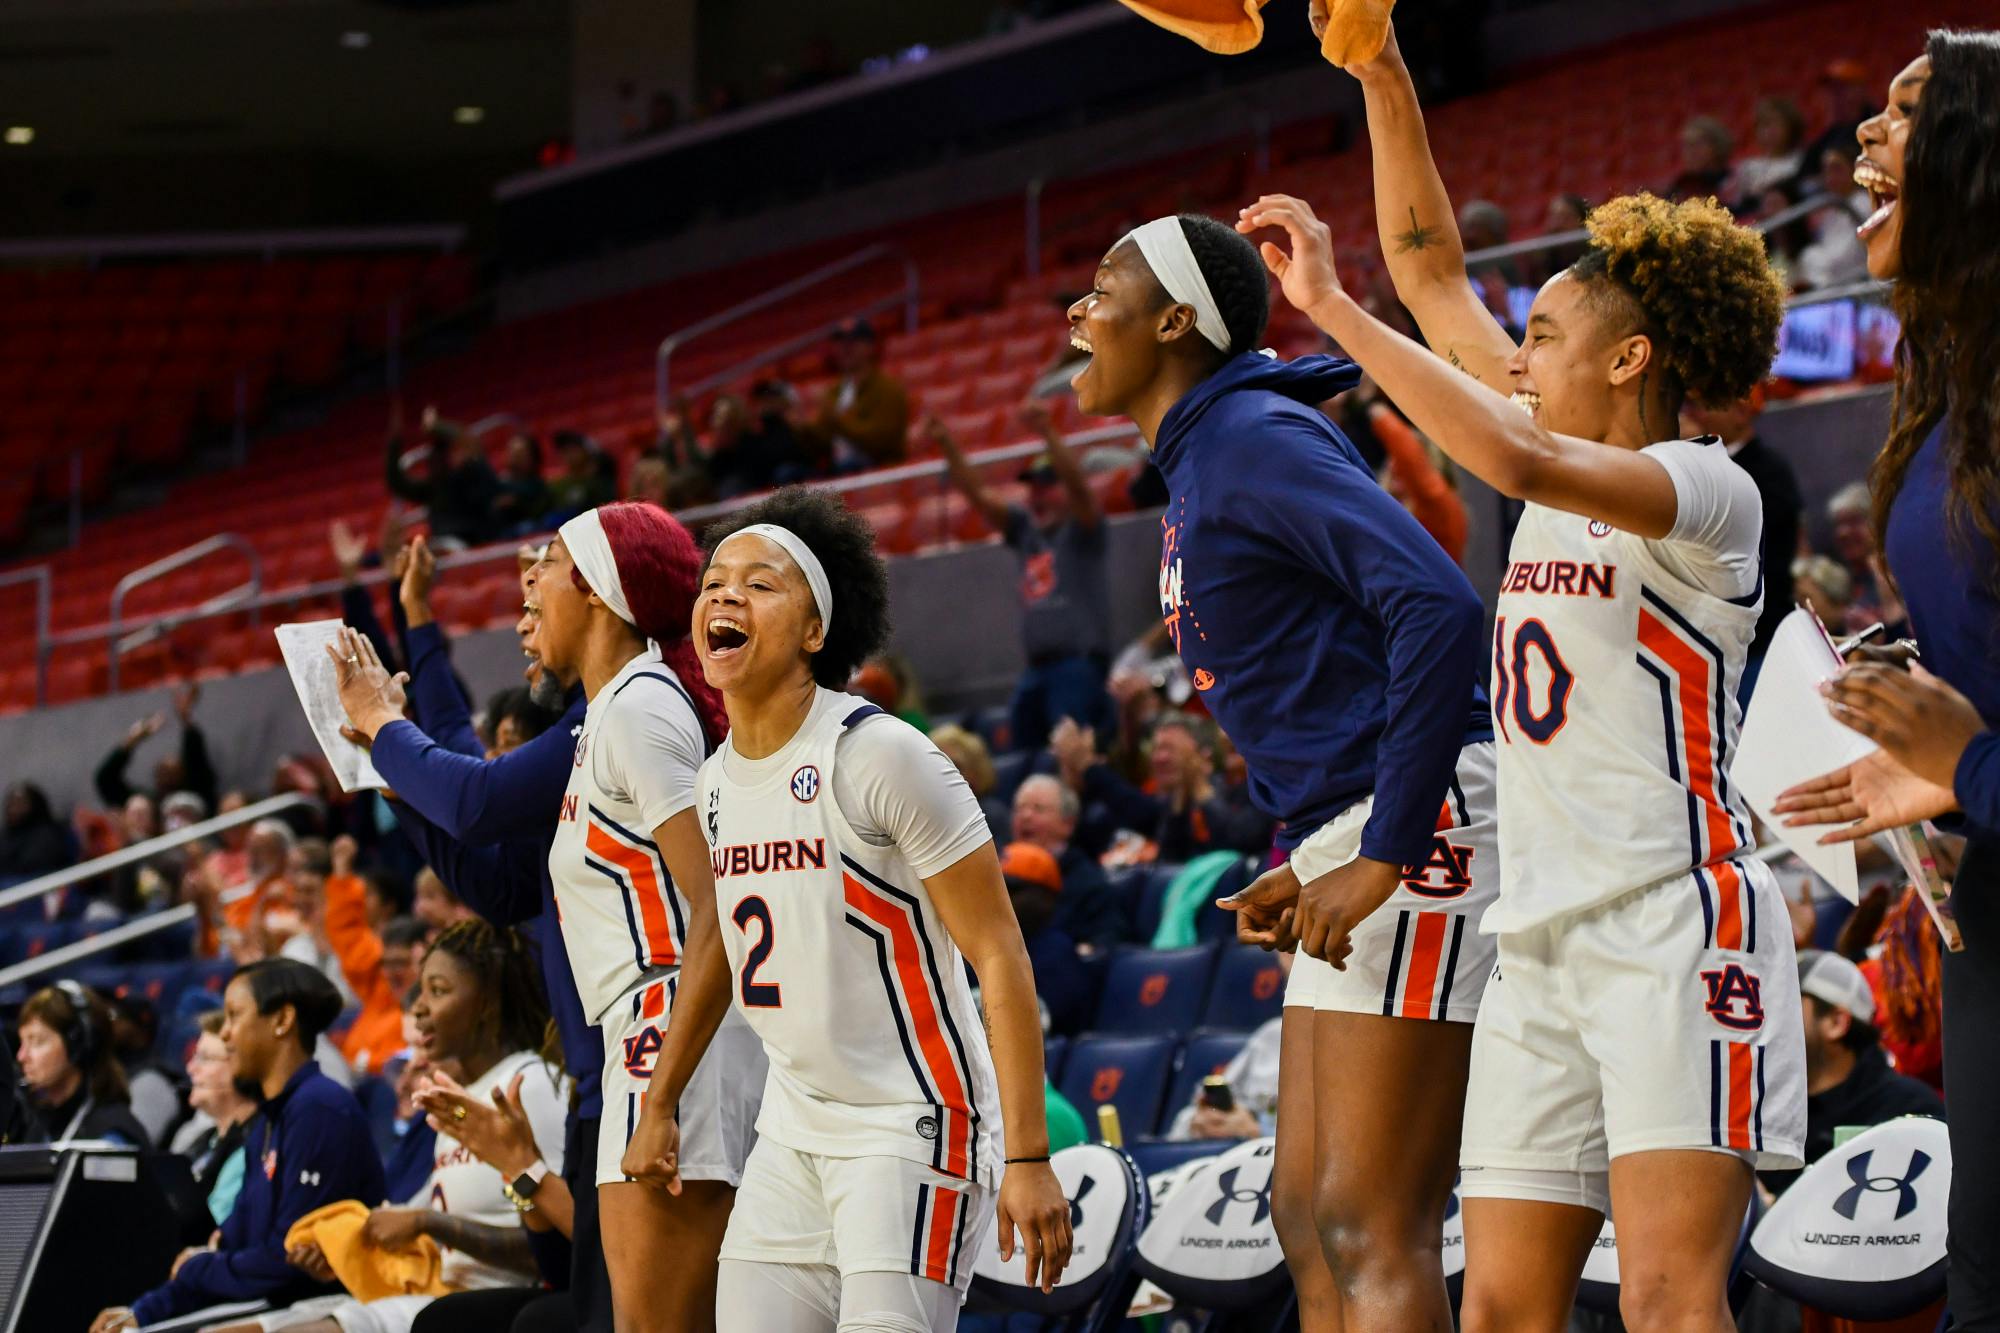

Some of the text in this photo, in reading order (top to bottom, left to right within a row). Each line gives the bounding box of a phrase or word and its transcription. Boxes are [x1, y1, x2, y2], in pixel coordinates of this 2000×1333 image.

[1495, 616, 1574, 745] 10
[792, 766, 819, 802] SEC
[732, 894, 782, 1009] 2
[1180, 1236, 1271, 1249] UNDER ARMOUR
[1804, 1232, 1921, 1246] UNDER ARMOUR
